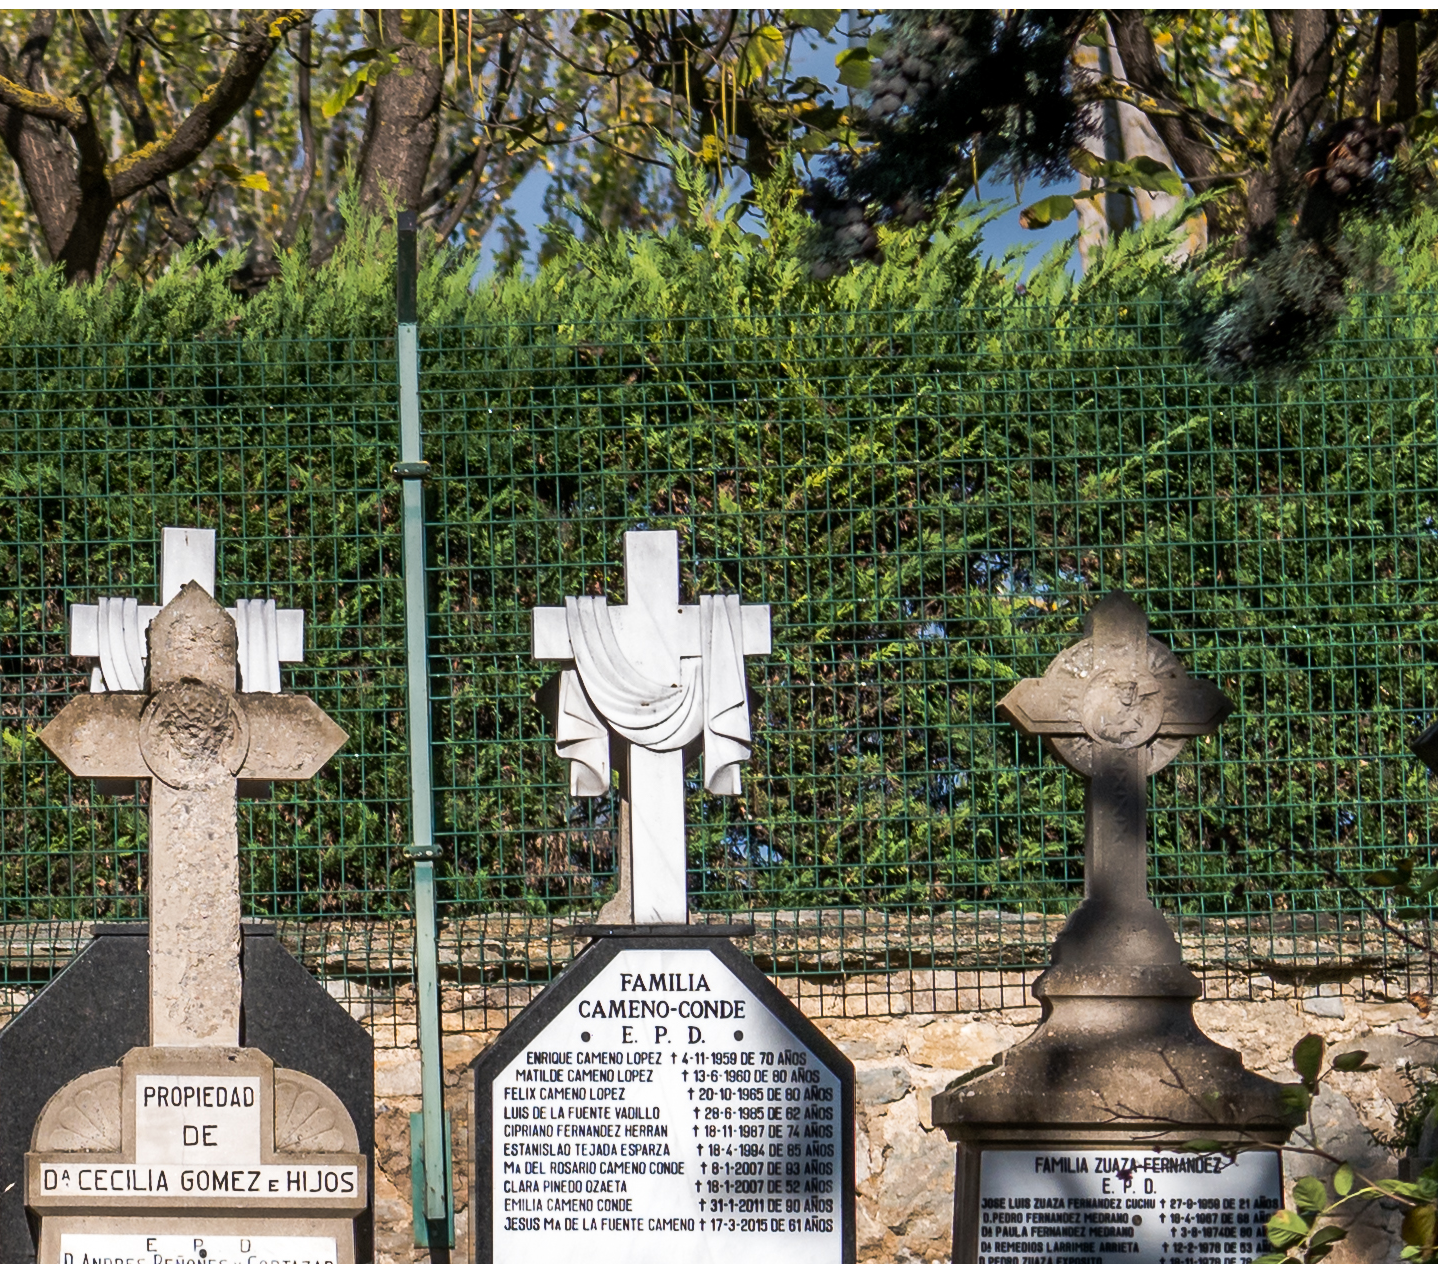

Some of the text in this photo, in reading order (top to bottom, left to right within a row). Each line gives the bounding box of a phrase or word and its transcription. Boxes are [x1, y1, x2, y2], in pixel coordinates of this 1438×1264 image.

[620, 973, 711, 992] FAMILIA
[527, 1052, 573, 1065] ENRIQUE
[577, 1052, 624, 1065] CAMENO
[627, 1052, 662, 1065] LOPEZ
[741, 1052, 755, 1066] DE
[759, 1052, 774, 1066] 70
[777, 1049, 807, 1066] AÑOS
[144, 1086, 254, 1108] PROPIEDAD
[504, 1106, 529, 1120] LUIS
[533, 1106, 546, 1120] DE
[551, 1106, 565, 1120] LA
[569, 1106, 611, 1120] FUENTE
[615, 1107, 660, 1120] VADILLO
[767, 1107, 782, 1120] DE
[786, 1107, 800, 1120] 62
[804, 1104, 834, 1121] AÑOS
[183, 1125, 218, 1147] DE
[79, 1169, 168, 1192] CECILIA
[181, 1170, 261, 1192] GOMEZ
[287, 1170, 354, 1193] HIJOS
